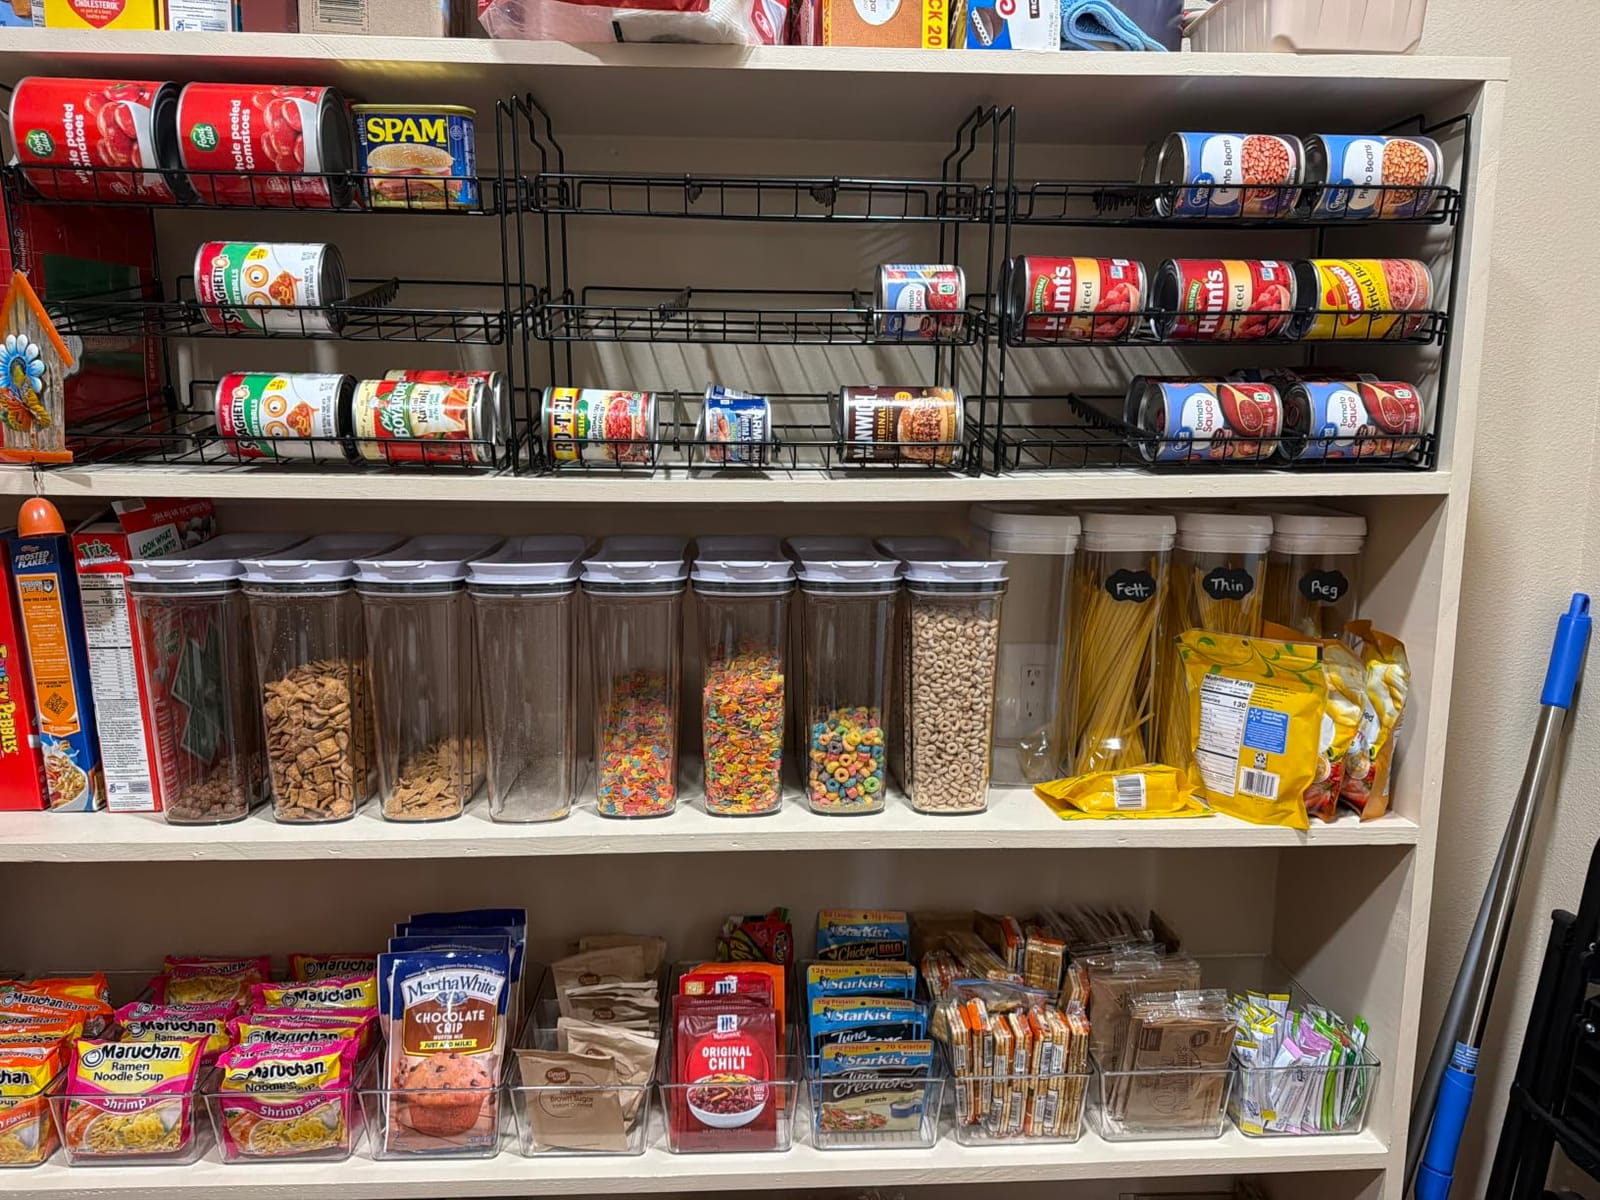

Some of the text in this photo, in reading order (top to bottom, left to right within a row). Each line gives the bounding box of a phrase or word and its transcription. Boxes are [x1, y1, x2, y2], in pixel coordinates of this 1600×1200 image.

[74, 0, 119, 10] CHOLESTEROL
[927, 25, 942, 47] 20
[63, 103, 78, 148] peeled
[367, 118, 447, 143] SPAM
[75, 114, 93, 175] tomatoes
[230, 100, 248, 179] hole peeled
[241, 109, 255, 169] tomatoes
[1221, 139, 1232, 193] Pnto Beans
[1364, 144, 1374, 172] Beans
[231, 268, 241, 305] EATBALLS
[418, 390, 430, 424] Ravioli
[1347, 396, 1356, 428] Sauce
[1195, 399, 1203, 432] Tomato
[1203, 399, 1213, 432] Sauce
[156, 528, 173, 545] WHAT
[15, 550, 49, 563] FROSTED
[77, 539, 111, 560] Trix
[18, 558, 48, 569] FLAKES
[1211, 578, 1243, 592] Thin
[1311, 580, 1338, 599] Reg
[1205, 674, 1253, 688] Nutrition Facts
[1233, 701, 1246, 709] 130
[836, 926, 890, 938] StarKist
[839, 943, 876, 960] Chicken
[317, 959, 378, 972] Marucha
[407, 973, 497, 1004] Martha White
[829, 978, 884, 988] StarKist
[13, 992, 63, 1008] Maruchan
[415, 1010, 485, 1023] CHOCOLATE
[835, 1010, 892, 1021] StarKist
[141, 1020, 217, 1034] Maruchan
[436, 1023, 463, 1034] CHIP
[831, 1030, 867, 1043] Tuna
[101, 1044, 181, 1060] Maruchan
[702, 1046, 752, 1057] ORIGINAL
[112, 1062, 149, 1071] Ramen
[708, 1058, 745, 1070] CHILI
[846, 1055, 908, 1065] StarKist
[94, 1071, 163, 1083] Noodle Soup
[248, 1061, 325, 1079] Maruchan
[833, 1078, 914, 1098] Creations
[103, 1097, 147, 1111] Shrimp
[260, 1104, 304, 1117] Shrimp
[6, 1110, 33, 1127] Flavor
